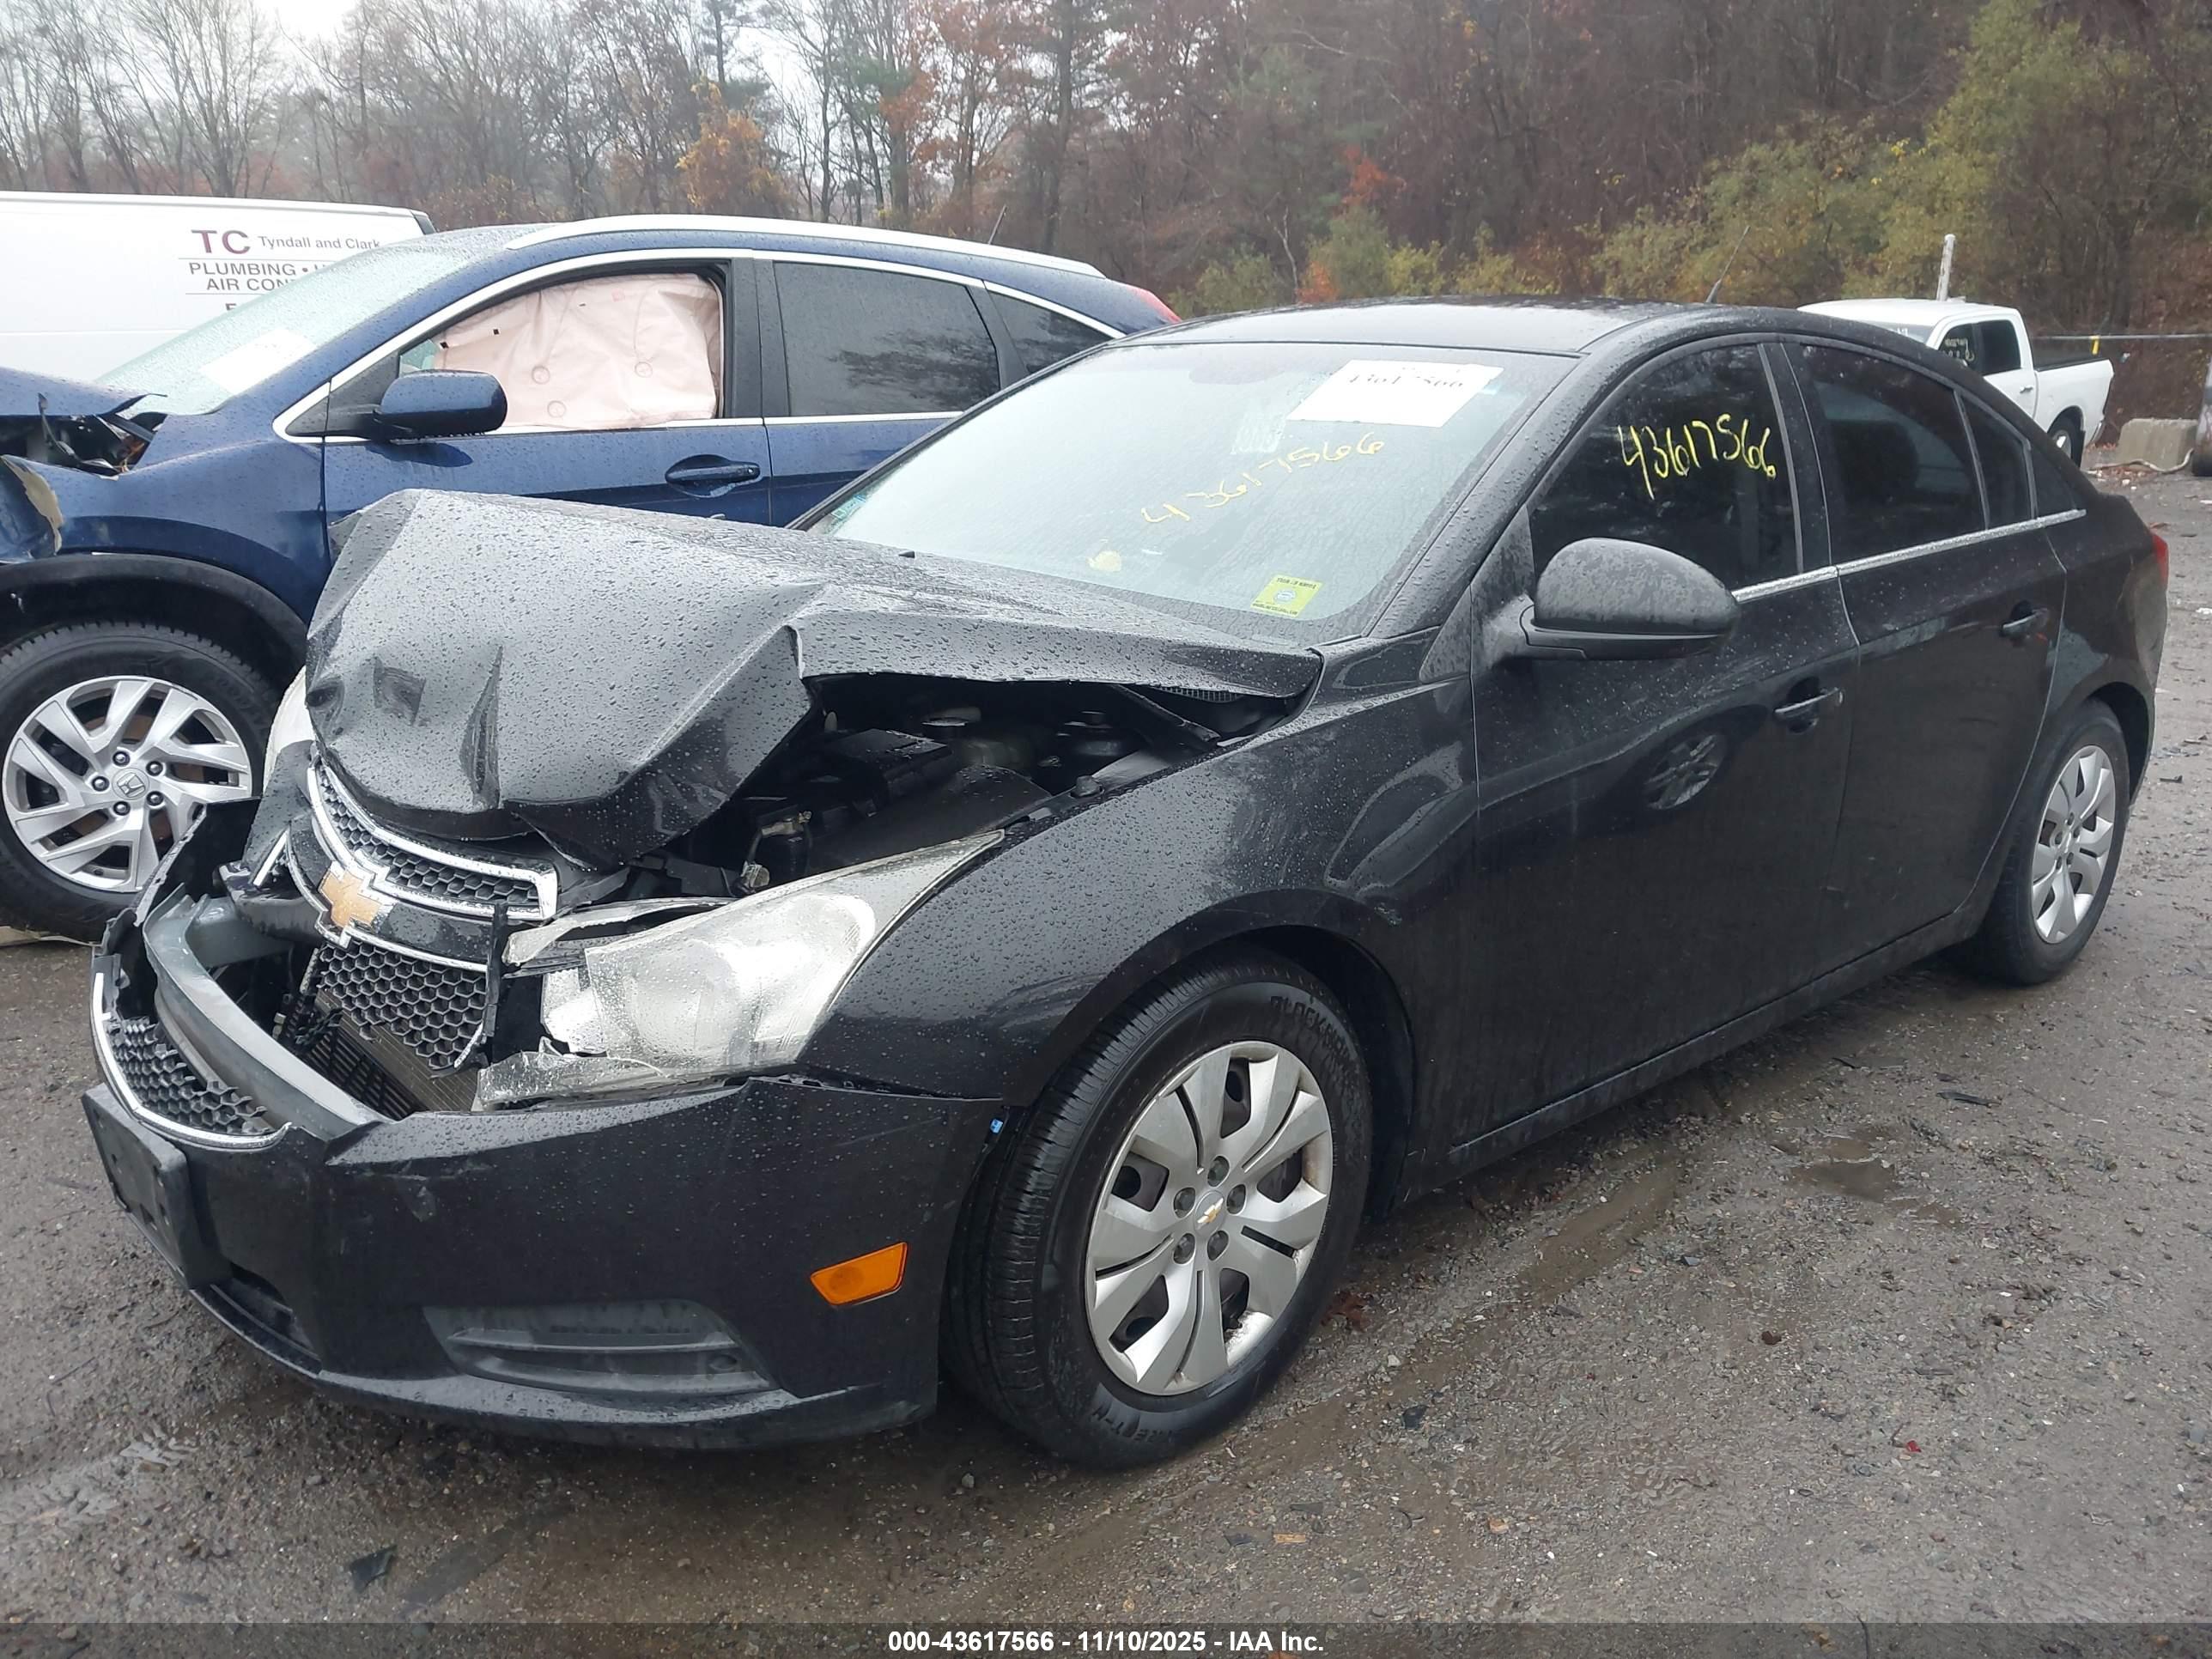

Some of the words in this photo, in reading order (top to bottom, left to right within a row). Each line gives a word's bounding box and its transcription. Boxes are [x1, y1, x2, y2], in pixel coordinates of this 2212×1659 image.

[191, 229, 251, 255] TC
[258, 236, 312, 250] Tyndall
[316, 238, 342, 249] and
[345, 238, 380, 250] Clark
[189, 263, 296, 276] PLUMBING
[207, 278, 240, 291] AIR
[246, 278, 295, 291] CON
[1618, 413, 1777, 500] 43617566
[1140, 432, 1384, 524] 43617566
